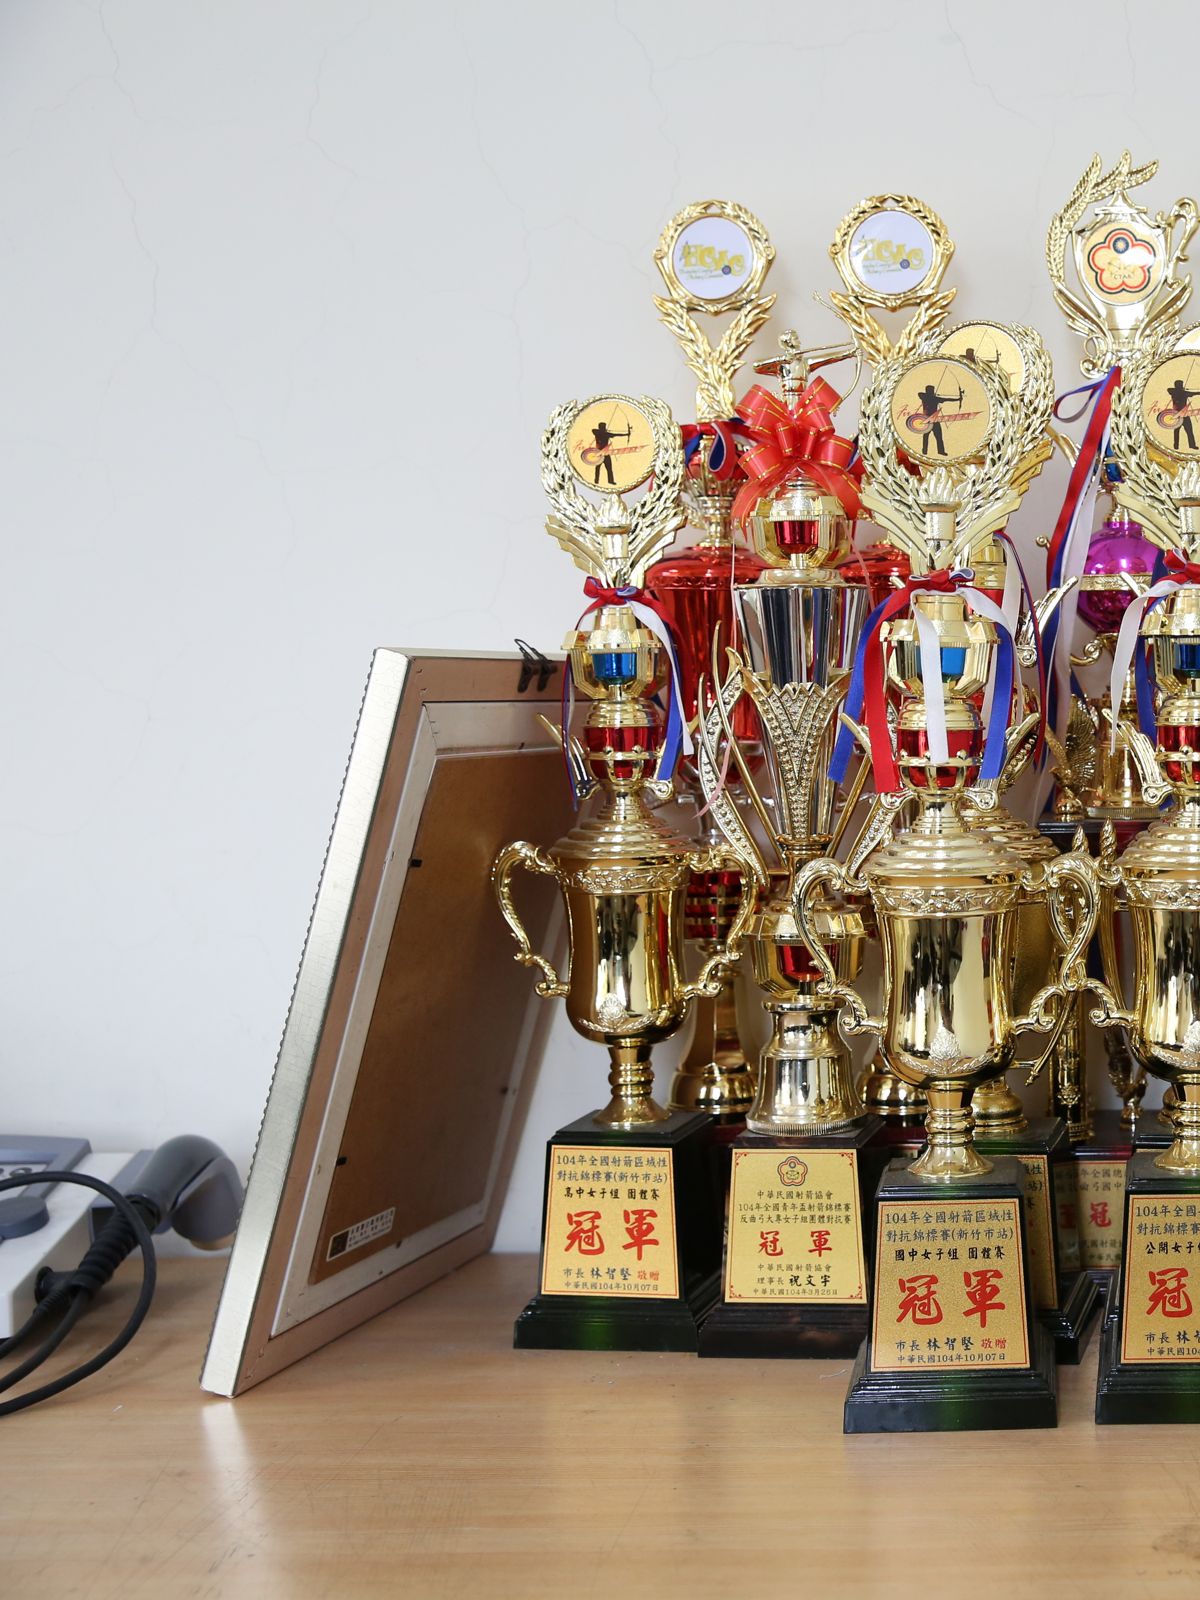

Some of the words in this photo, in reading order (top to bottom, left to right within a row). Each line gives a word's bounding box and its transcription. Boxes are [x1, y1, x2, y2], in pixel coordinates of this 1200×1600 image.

[556, 1155, 668, 1168] 104年全國射箭區域性
[556, 1170, 668, 1184] 對抗錦標賽(新竹市站)
[564, 1187, 620, 1199] 高中女子組
[627, 1188, 660, 1200] 團體賽
[757, 1190, 834, 1200] 中華民國射箭協會
[739, 1214, 852, 1225] 反曲弓大專女子組團體對抗賽
[885, 1209, 1014, 1225] 104年全國射箭區域性
[886, 1227, 1014, 1243] 對抗錦標賽(新竹市站)
[895, 1248, 959, 1262] 國中女子組
[968, 1245, 1006, 1260] 團體賽
[563, 1268, 585, 1279] 市長
[590, 1267, 632, 1281] 林智堅
[757, 1263, 832, 1273] 中華民國射箭協會
[757, 1276, 784, 1286] 理事長
[896, 1339, 920, 1351] 市長
[926, 1336, 974, 1351] 林智堅
[1145, 1332, 1170, 1344] 市長
